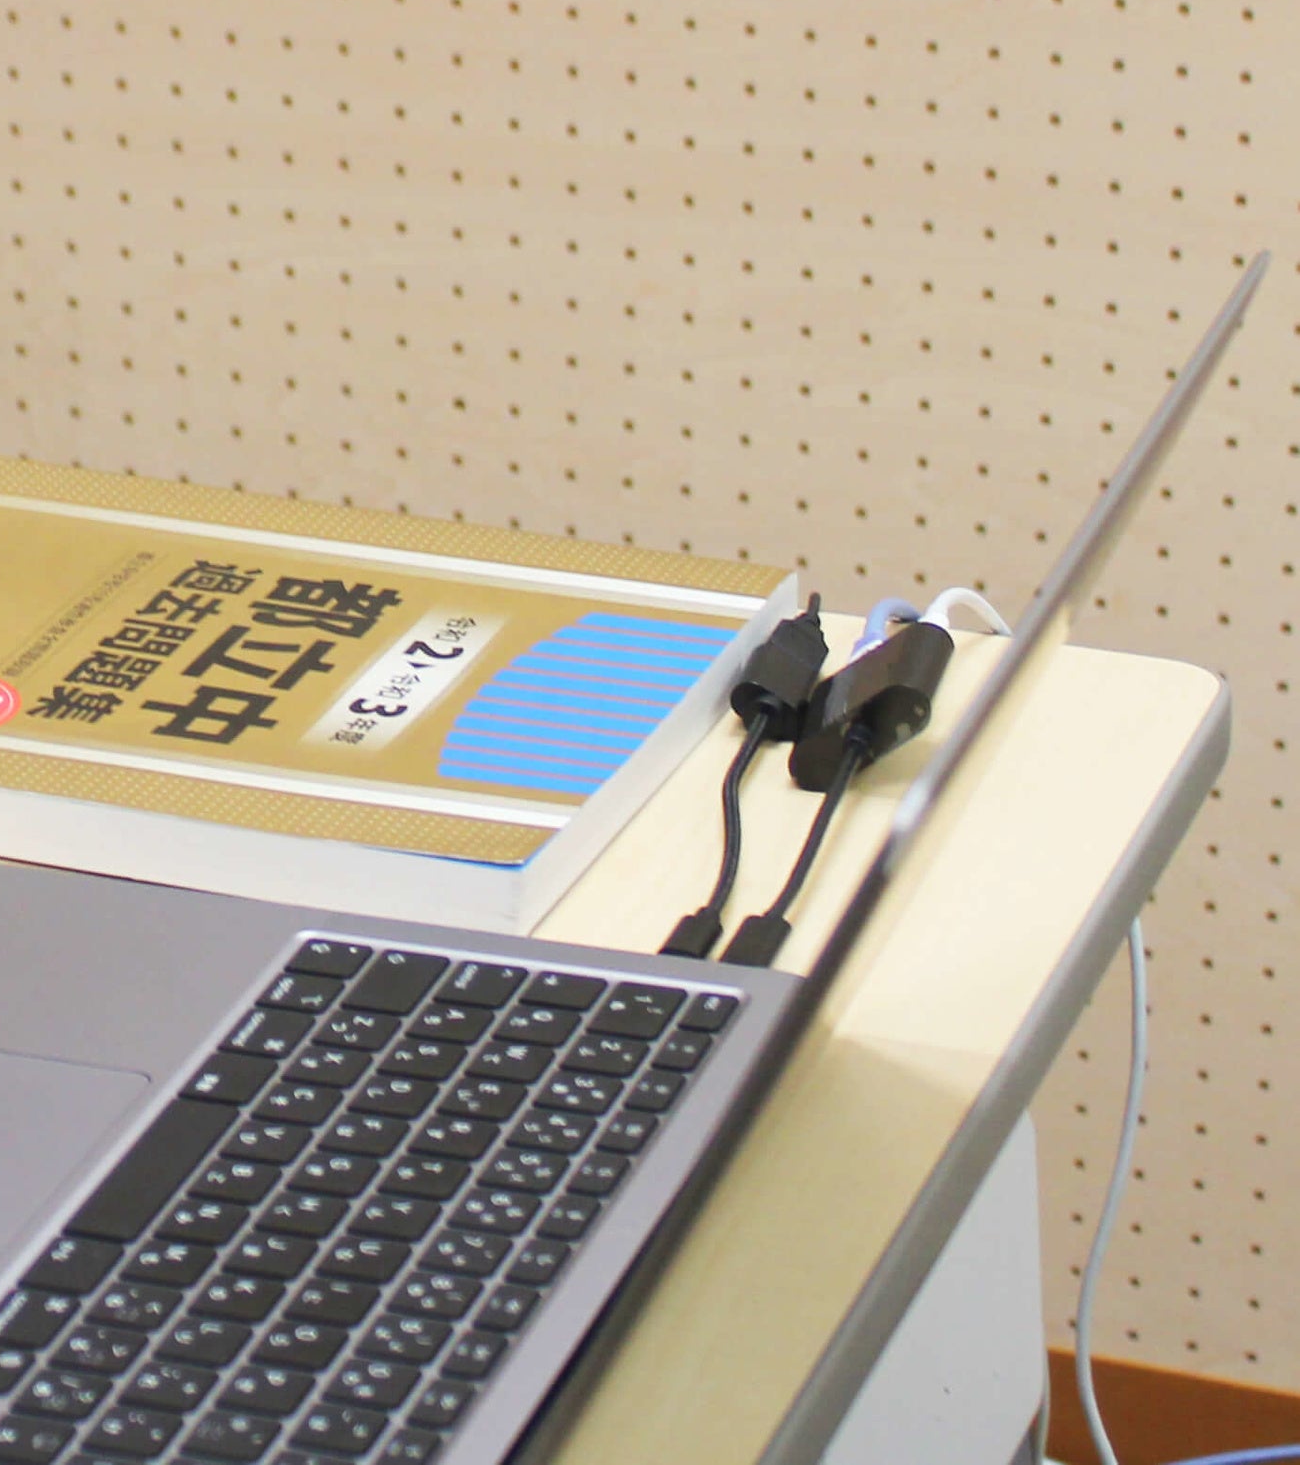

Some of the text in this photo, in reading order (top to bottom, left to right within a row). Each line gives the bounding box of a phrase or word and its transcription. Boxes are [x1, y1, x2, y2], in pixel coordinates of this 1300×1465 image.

[26, 559, 262, 723] 過去問題集
[140, 575, 402, 745] 都立中
